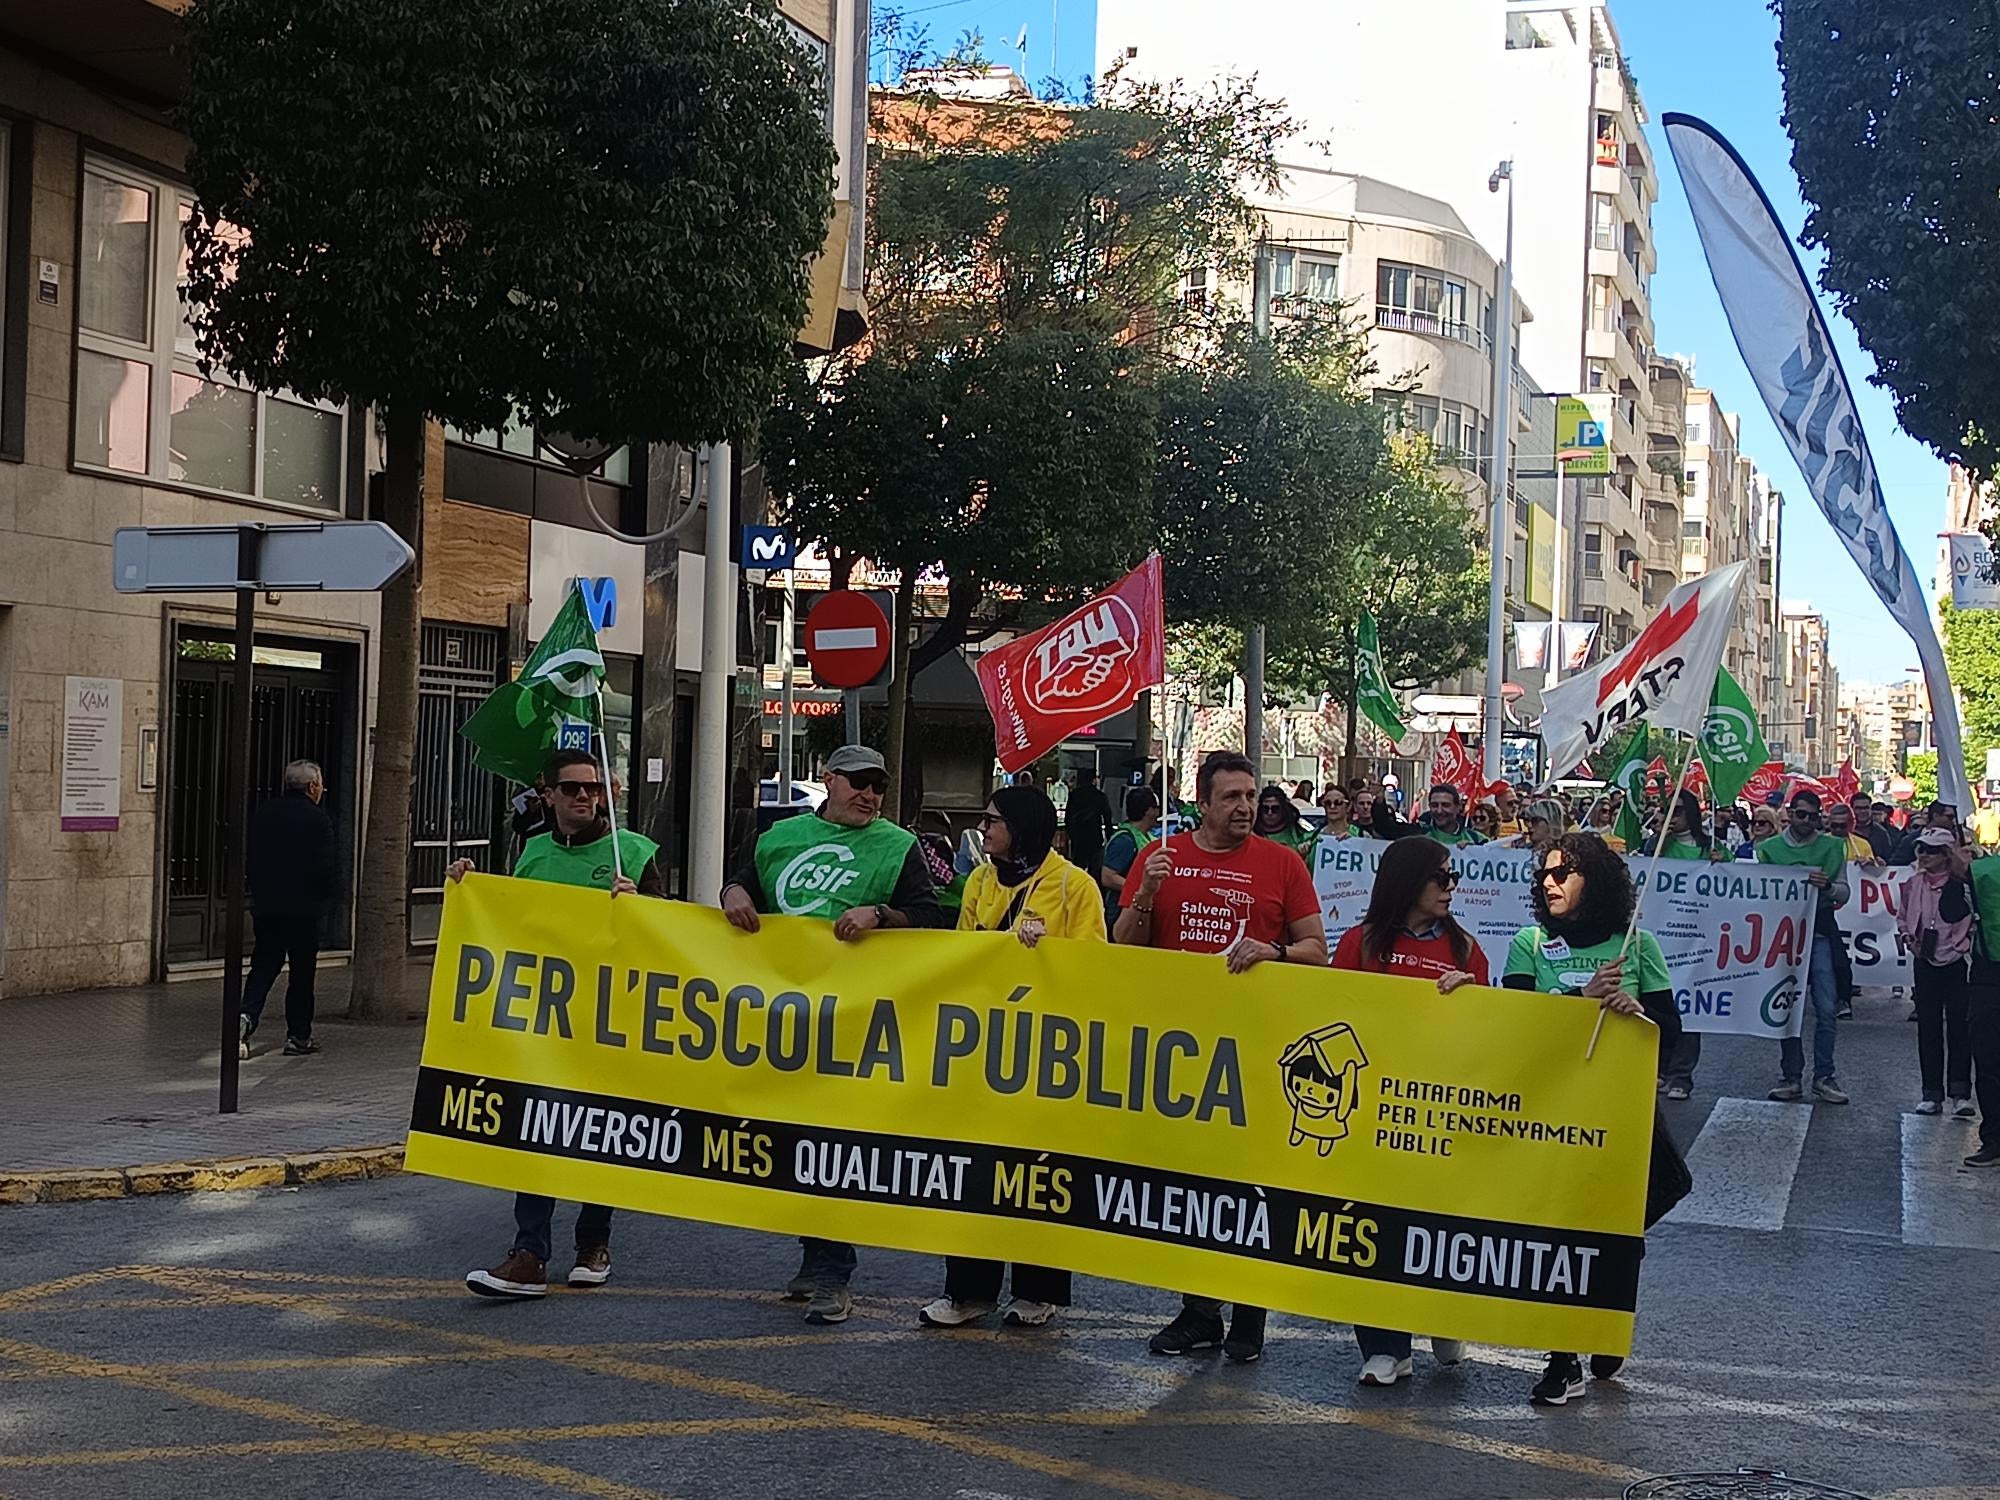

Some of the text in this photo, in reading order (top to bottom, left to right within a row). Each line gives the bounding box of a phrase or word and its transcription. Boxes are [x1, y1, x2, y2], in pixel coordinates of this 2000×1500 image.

[1583, 423, 1599, 444] P
[1566, 460, 1605, 469] LIENTES
[79, 690, 109, 712] KAM
[564, 731, 586, 749] 29€
[1132, 771, 1143, 784] P
[1174, 866, 1201, 878] UGT
[1320, 848, 1364, 873] PER
[789, 862, 860, 894] CSIF
[1656, 870, 1689, 895] DE
[1695, 873, 1811, 901] QUALITAT
[1180, 901, 1232, 917] Salvem
[1180, 914, 1232, 931] l'escola
[1179, 928, 1229, 944] pública
[1676, 988, 1734, 1017] GNE
[452, 943, 1248, 1127] PER L'ESCOLA PÚBLICA
[1380, 1076, 1522, 1112] PLATAFORMA
[1377, 1103, 1608, 1148] PER L'ENSENYAMENT
[1375, 1125, 1454, 1158] PÚBLIC
[440, 1078, 1600, 1296] MÉS INVERSIÓ MÉS QUALITAT MÉS VALENCIÀ MÉS DIGNITAT
